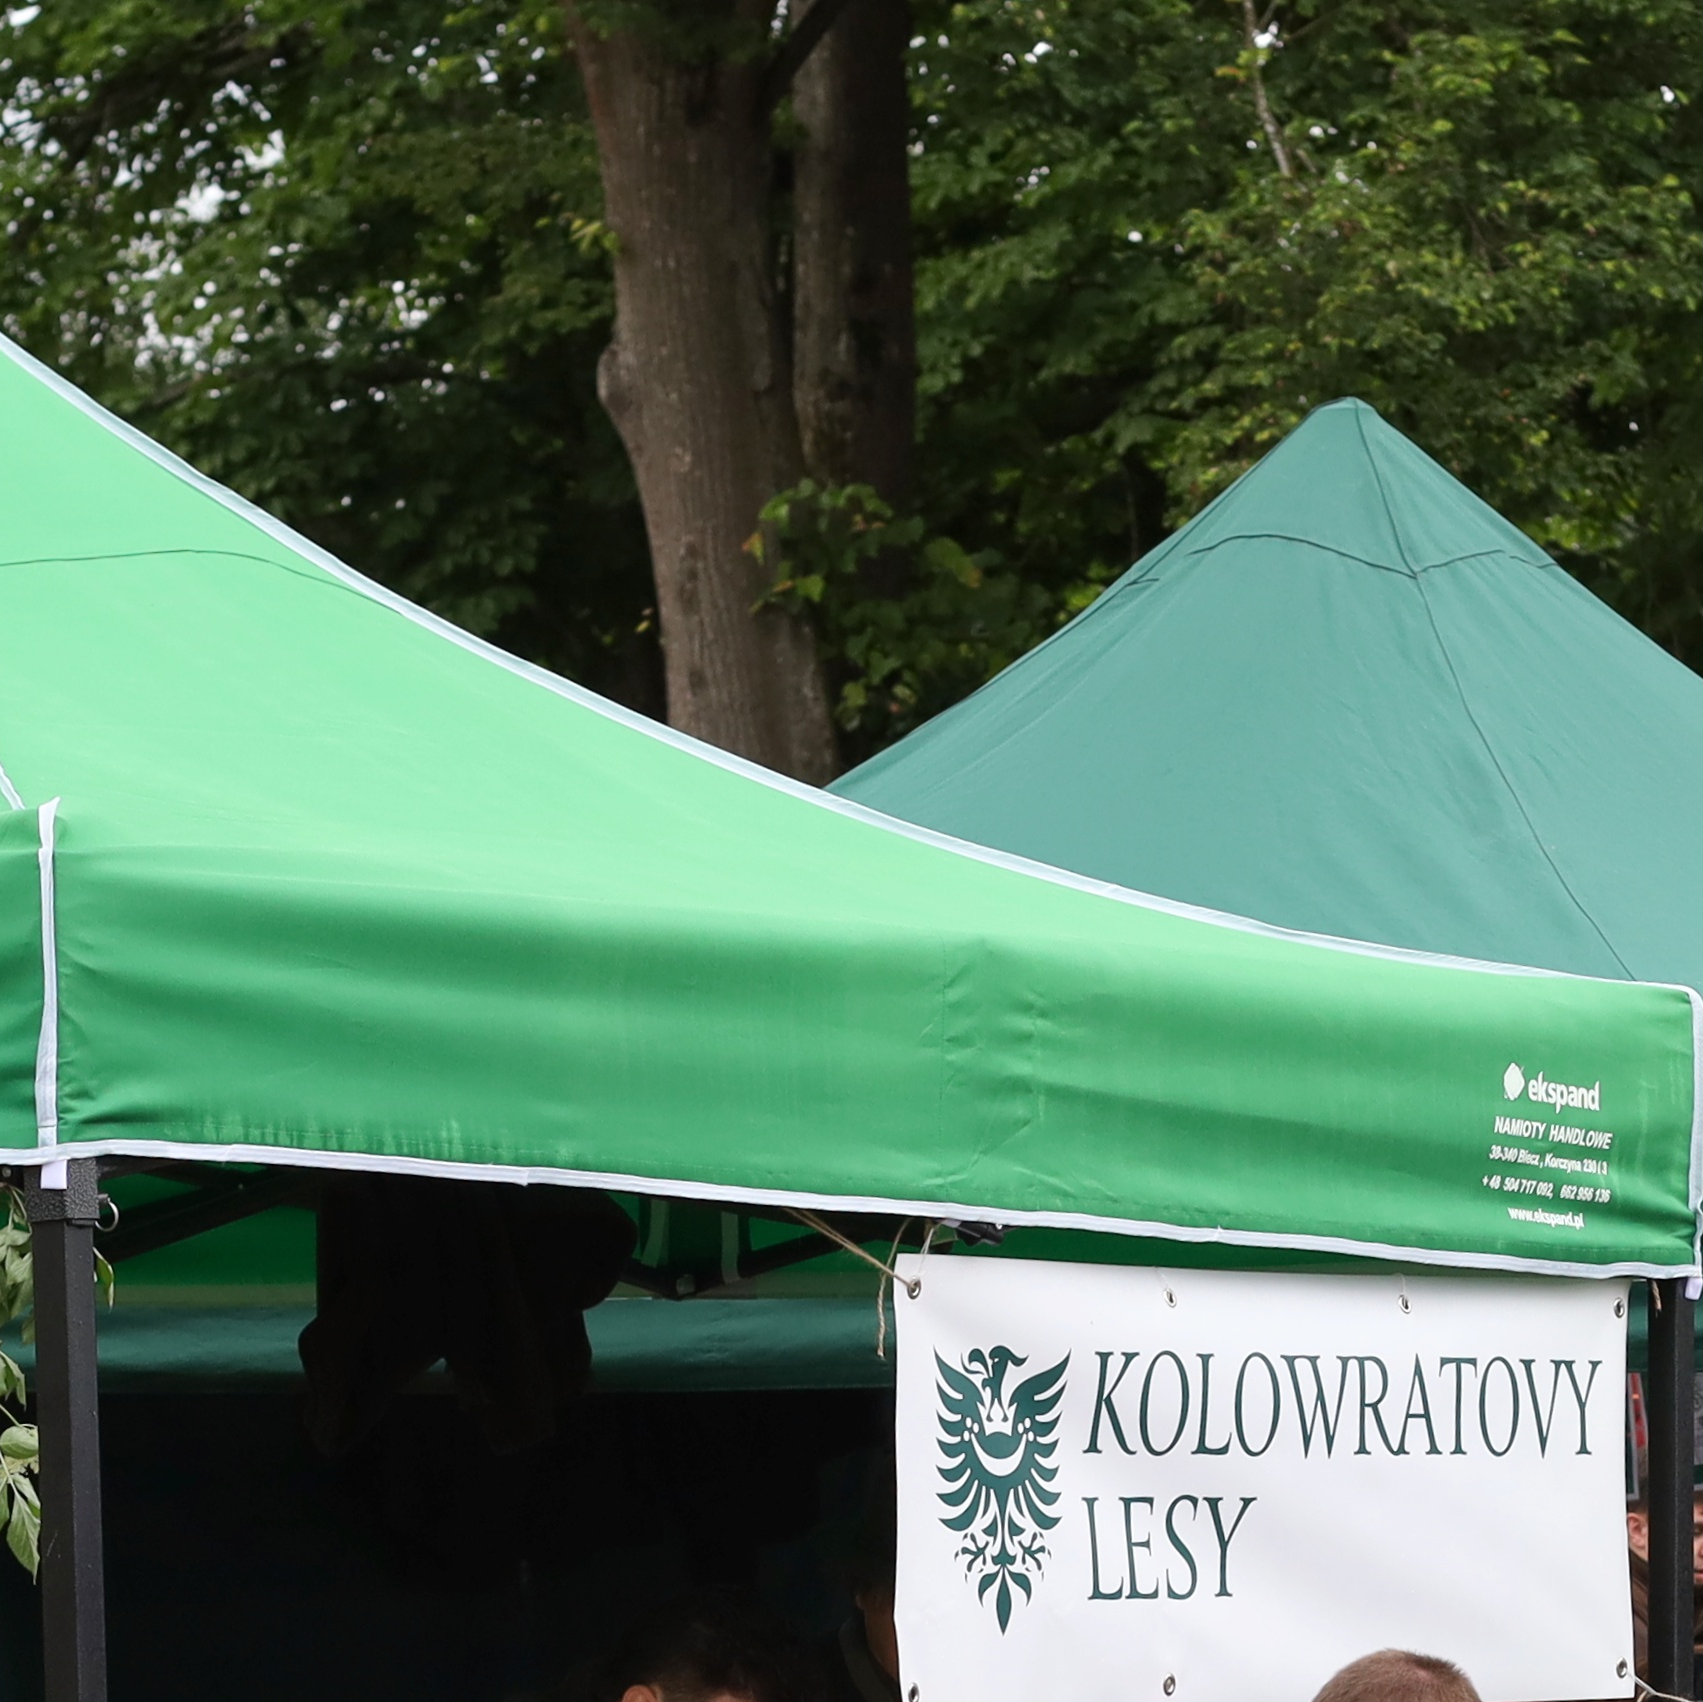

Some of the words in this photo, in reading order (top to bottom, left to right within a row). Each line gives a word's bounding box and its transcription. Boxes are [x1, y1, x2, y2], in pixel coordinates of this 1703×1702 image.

[1528, 1071, 1600, 1114] ekspand
[1494, 1115, 1547, 1140] NAMIOTY
[1549, 1124, 1613, 1149] HANDLOWE
[1544, 1153, 1582, 1174] Korczyna
[1503, 1176, 1520, 1193] 504
[1519, 1179, 1538, 1195] 717
[1560, 1184, 1577, 1200] 662
[1576, 1186, 1595, 1202] 956
[1594, 1188, 1612, 1203] 136
[1508, 1207, 1585, 1230] www.ekspand.pl
[1082, 1350, 1602, 1458] KOLOWRATOVY
[1082, 1495, 1257, 1601] LESY
